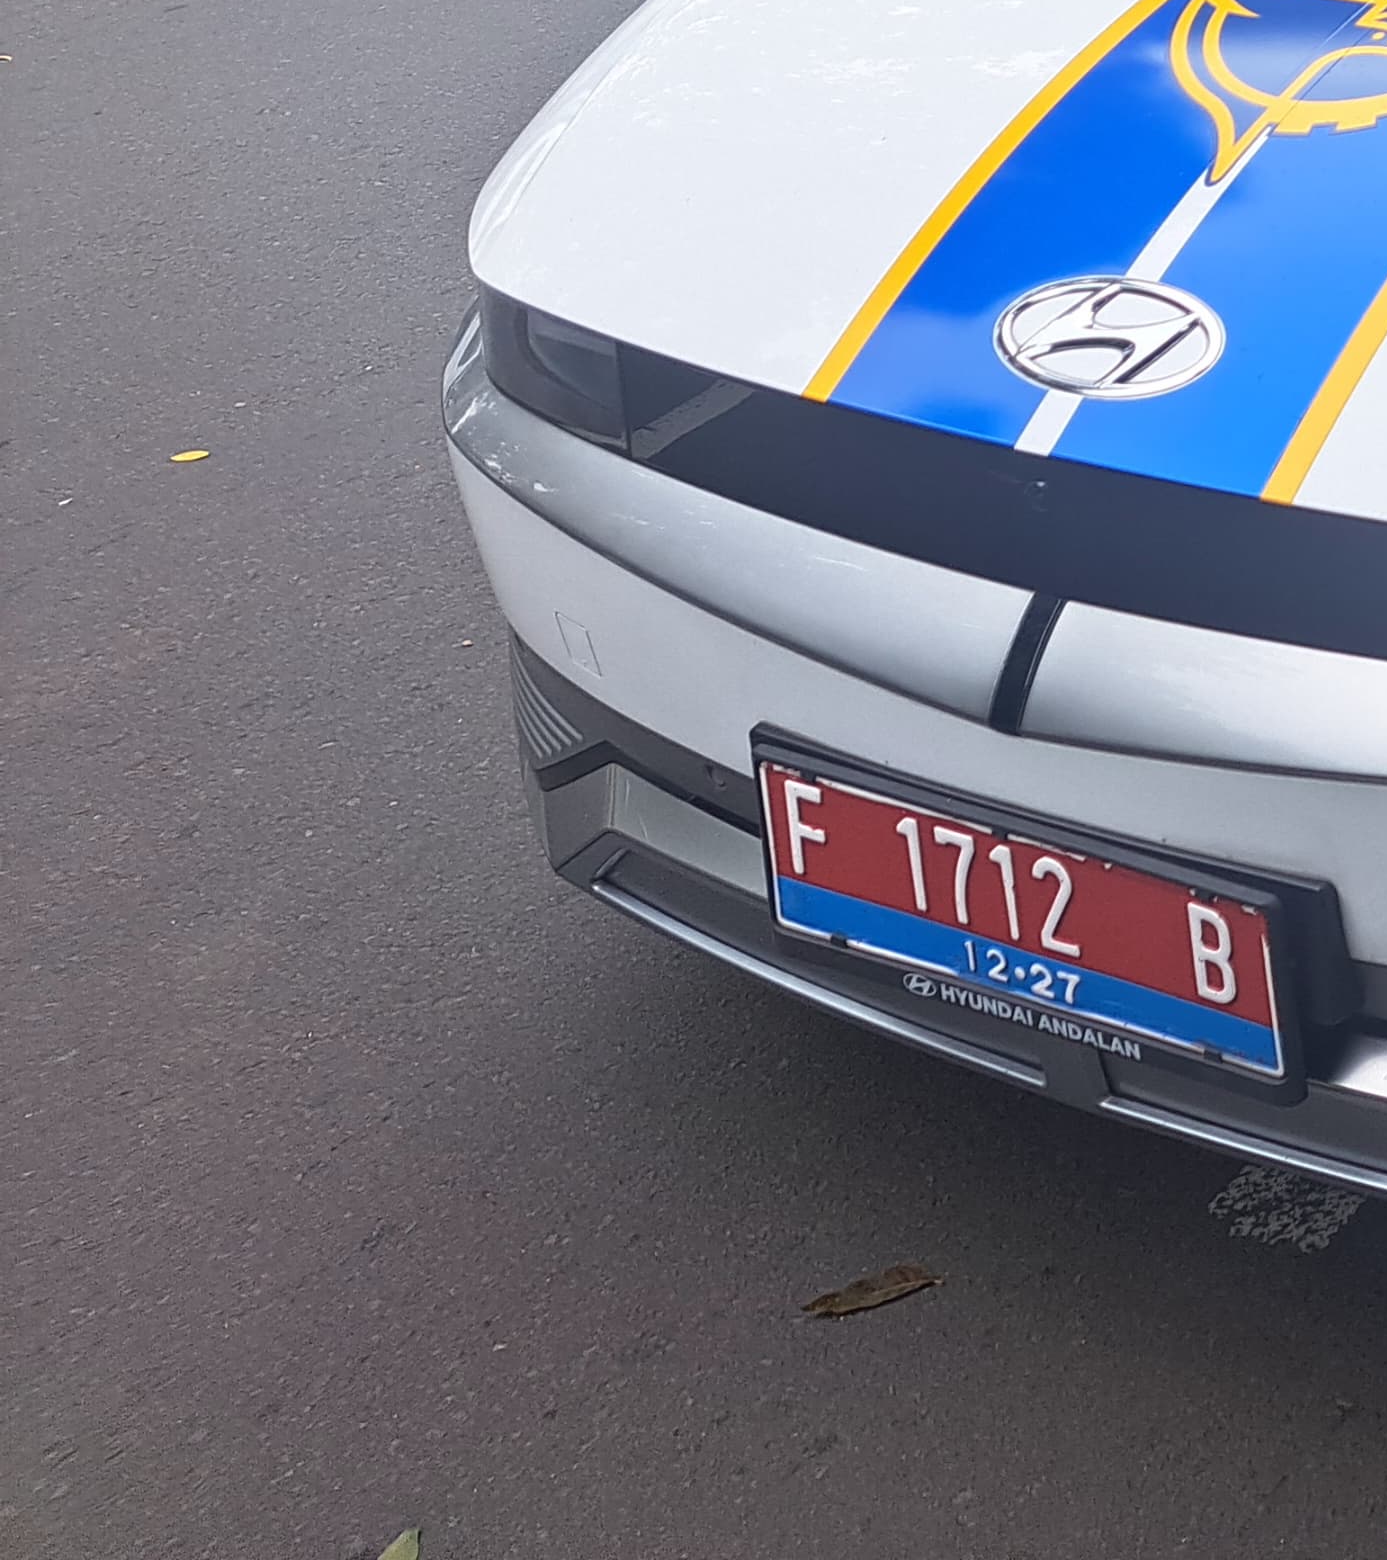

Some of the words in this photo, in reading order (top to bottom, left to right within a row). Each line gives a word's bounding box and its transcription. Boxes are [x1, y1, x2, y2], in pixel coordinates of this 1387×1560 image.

[784, 779, 826, 875] F
[896, 816, 1081, 958] 1712
[1186, 901, 1237, 1004] B
[941, 982, 1033, 1027] HYUNDAI
[1038, 1015, 1142, 1061] ANDALAN
